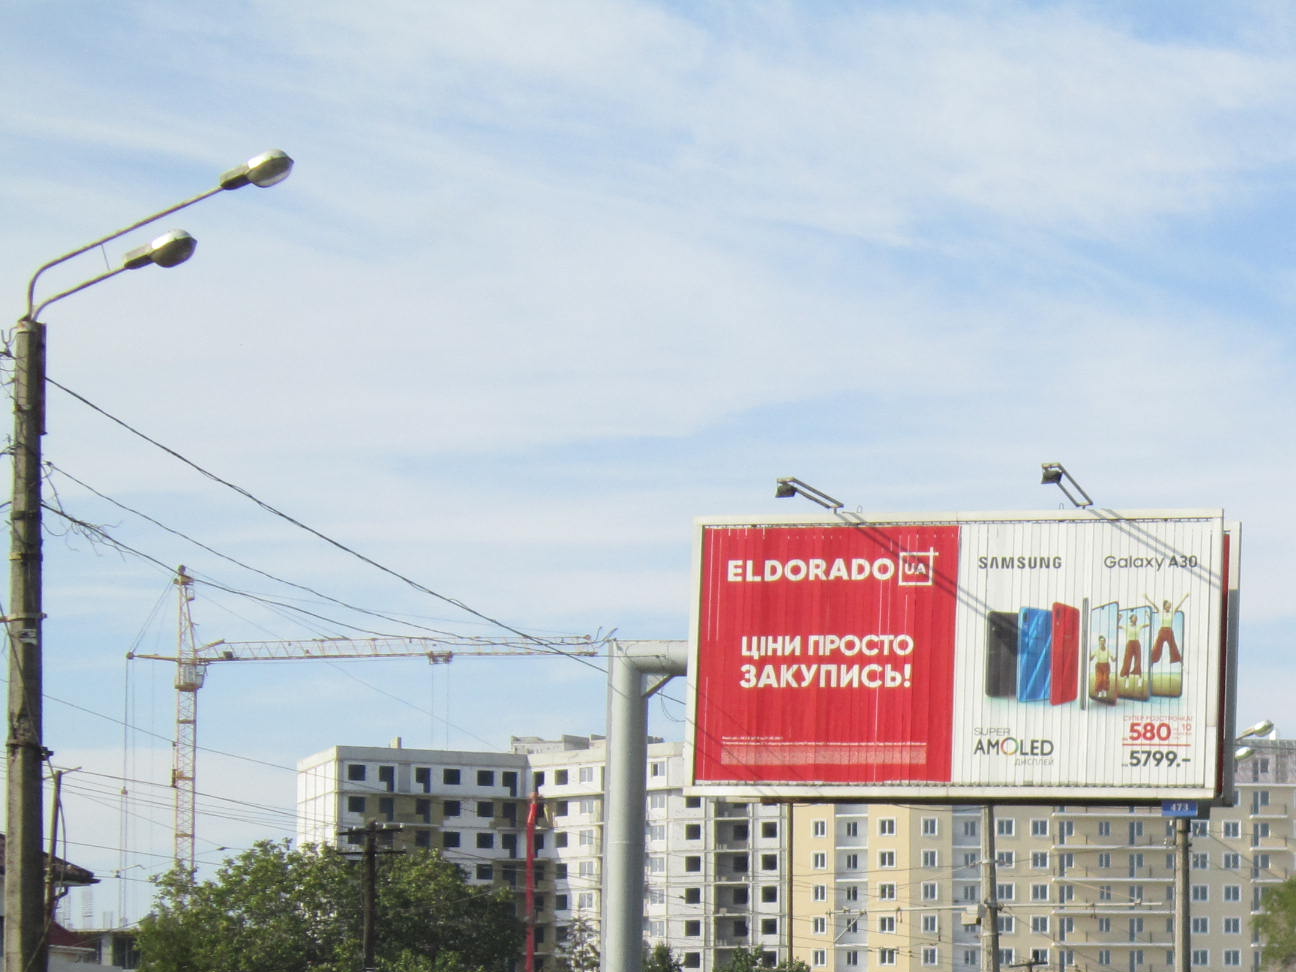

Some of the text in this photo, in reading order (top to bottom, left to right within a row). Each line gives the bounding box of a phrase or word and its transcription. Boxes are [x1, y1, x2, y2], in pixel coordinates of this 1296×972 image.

[727, 558, 926, 582] ELDORADO UA
[978, 556, 1062, 569] SAMSUNG
[1104, 555, 1198, 572] Galaxy A30
[741, 634, 914, 660] ЦІНИ ПРОСТО
[739, 664, 913, 688] ЗАКУПИСЬ!
[974, 727, 1011, 737] SUPER
[1129, 722, 1171, 741] 580
[974, 737, 1054, 757] AMOLED
